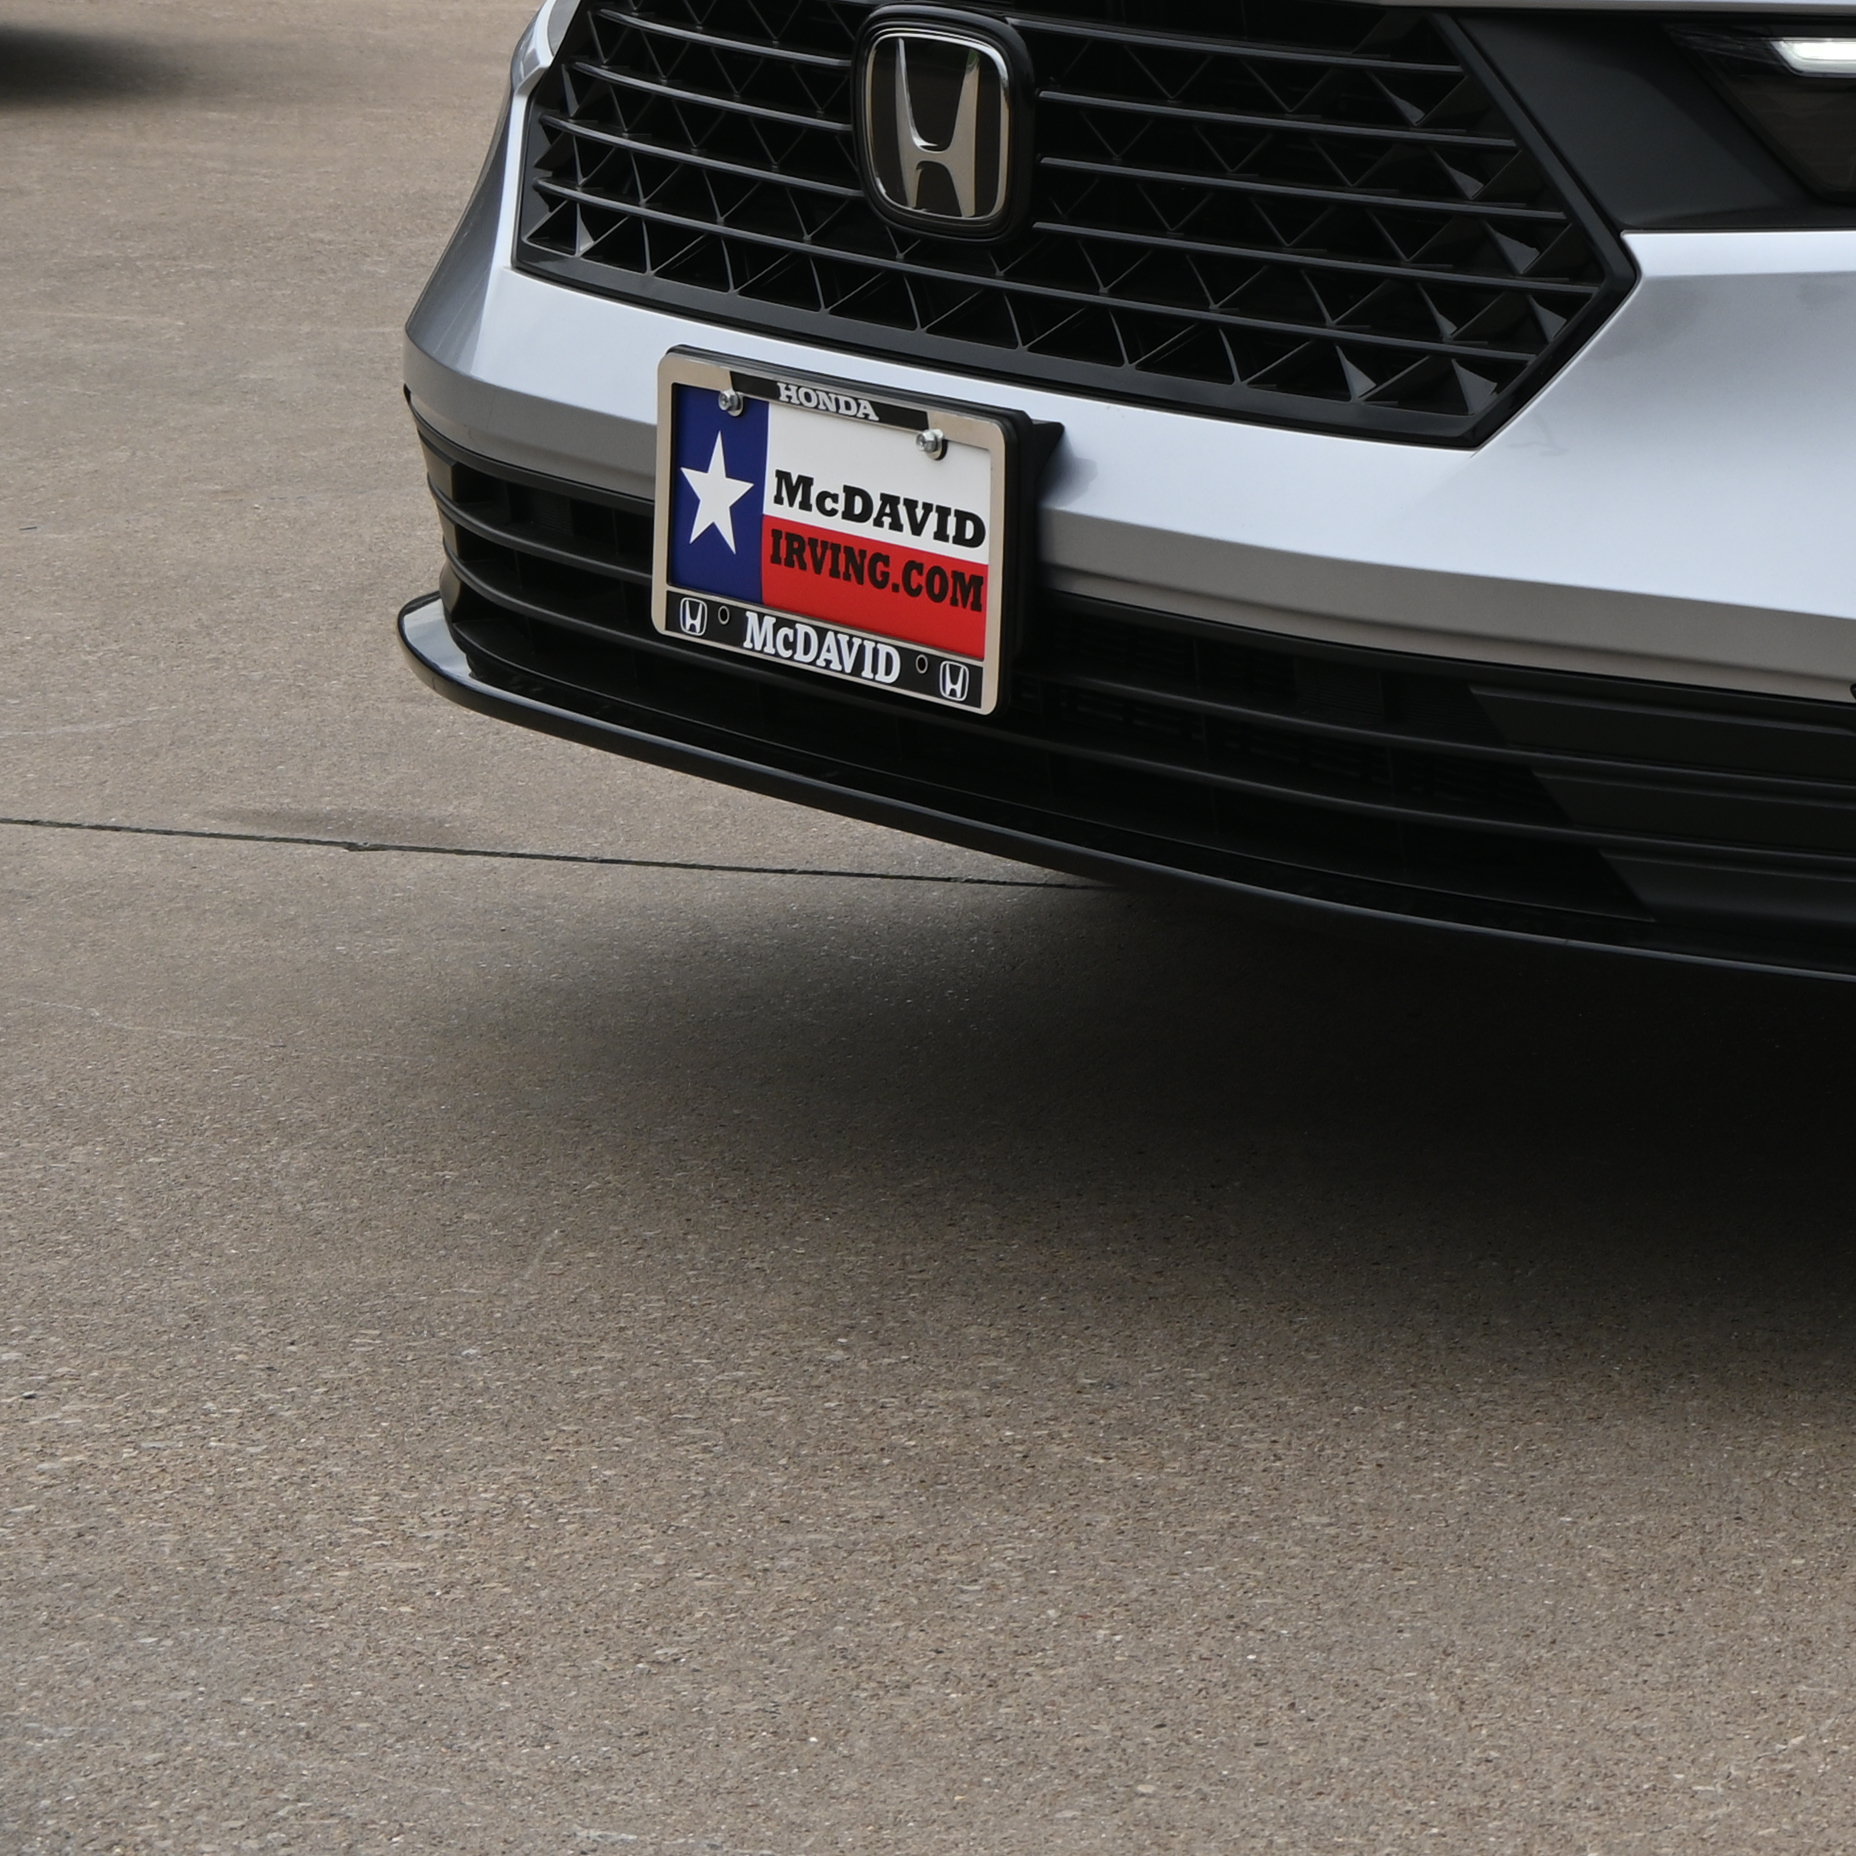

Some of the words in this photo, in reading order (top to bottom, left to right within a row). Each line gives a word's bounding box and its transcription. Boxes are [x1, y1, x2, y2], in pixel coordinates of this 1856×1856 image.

[776, 381, 879, 422] HONDA
[773, 469, 986, 548] McDAVID
[770, 528, 985, 612] IRVING.COM
[743, 610, 901, 685] McDAVID
